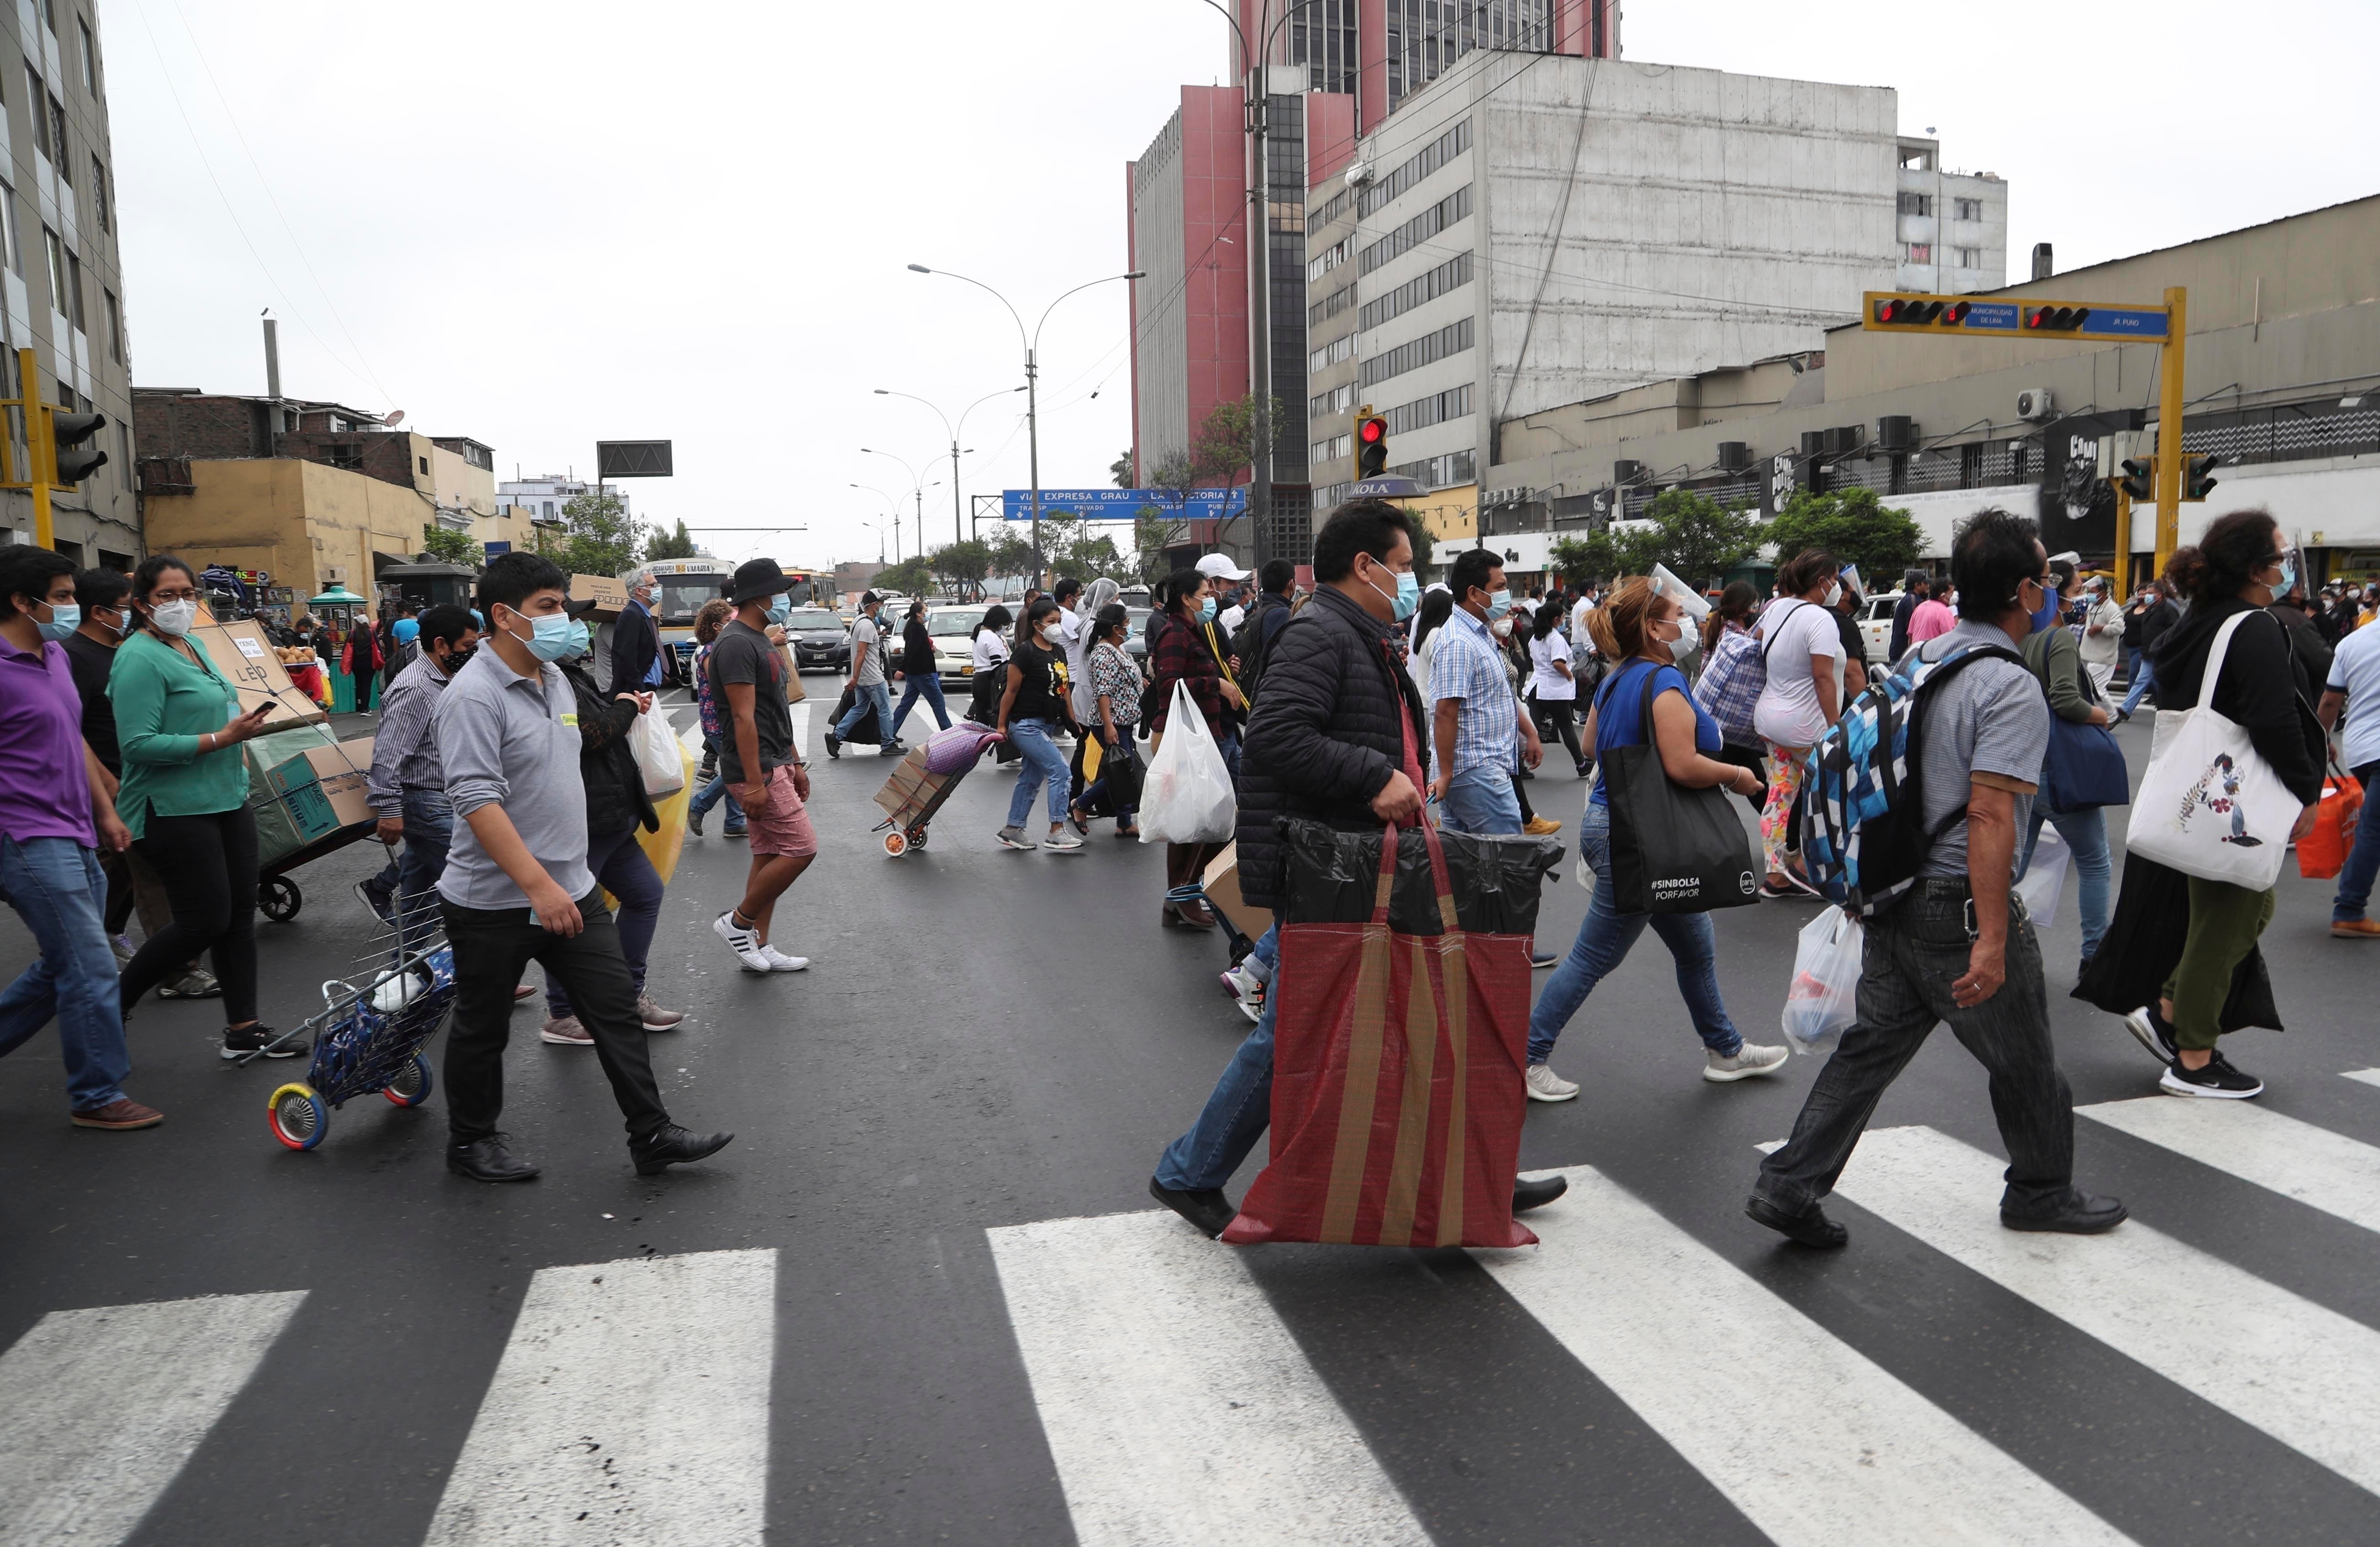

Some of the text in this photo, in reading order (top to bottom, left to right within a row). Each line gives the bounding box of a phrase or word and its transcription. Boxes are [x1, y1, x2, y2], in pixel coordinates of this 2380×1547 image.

[1971, 307, 2013, 316] MUNICIPALIDAD
[2122, 319, 2139, 327] PUNO
[1044, 492, 1093, 500] EXPRESA
[1101, 492, 1129, 500] GRAU
[235, 665, 267, 682] LED
[1651, 877, 1754, 889] #SINBOLSA paris
[1655, 888, 1699, 901] PORFAVOR
